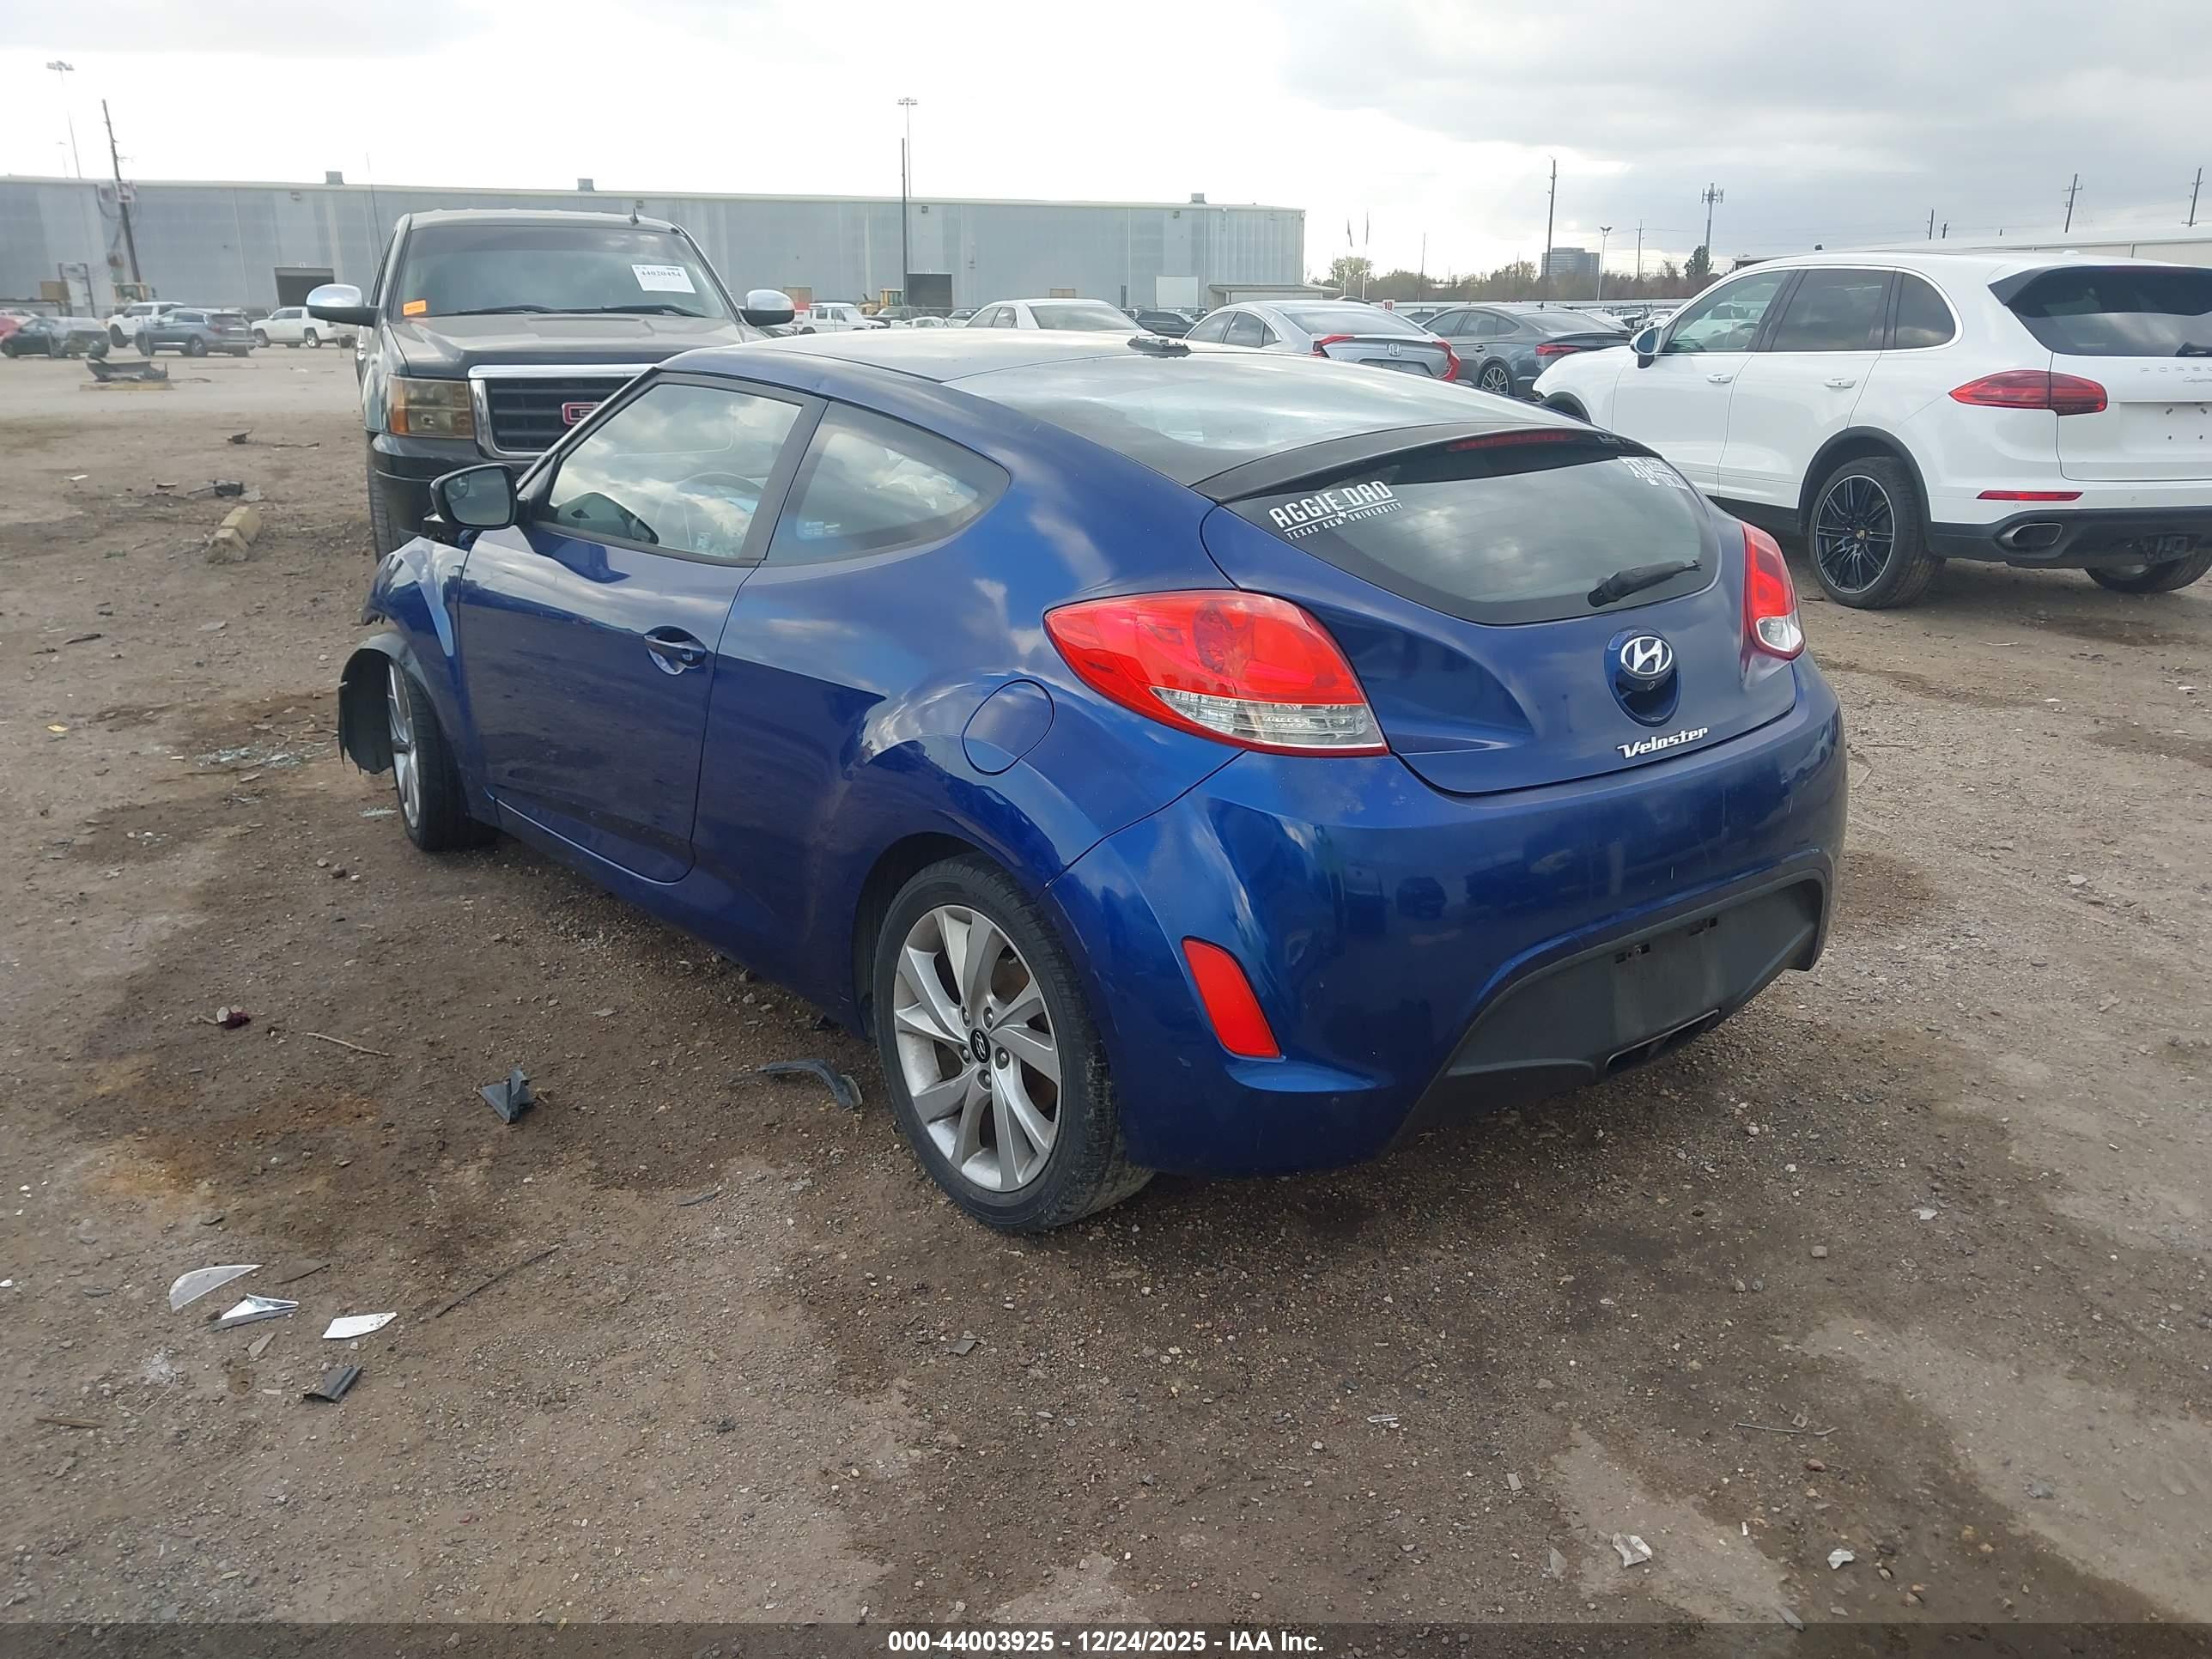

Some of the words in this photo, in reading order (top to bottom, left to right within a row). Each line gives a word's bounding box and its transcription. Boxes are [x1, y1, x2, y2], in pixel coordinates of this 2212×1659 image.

[1383, 301, 1393, 310] 10
[1268, 492, 1345, 529] AGGIE
[1340, 480, 1394, 507] DAD
[1286, 525, 1320, 541] TEXAS
[1322, 517, 1345, 530] A&M
[1347, 501, 1404, 522] UNIVERSITY
[1616, 726, 1709, 760] Veloster
